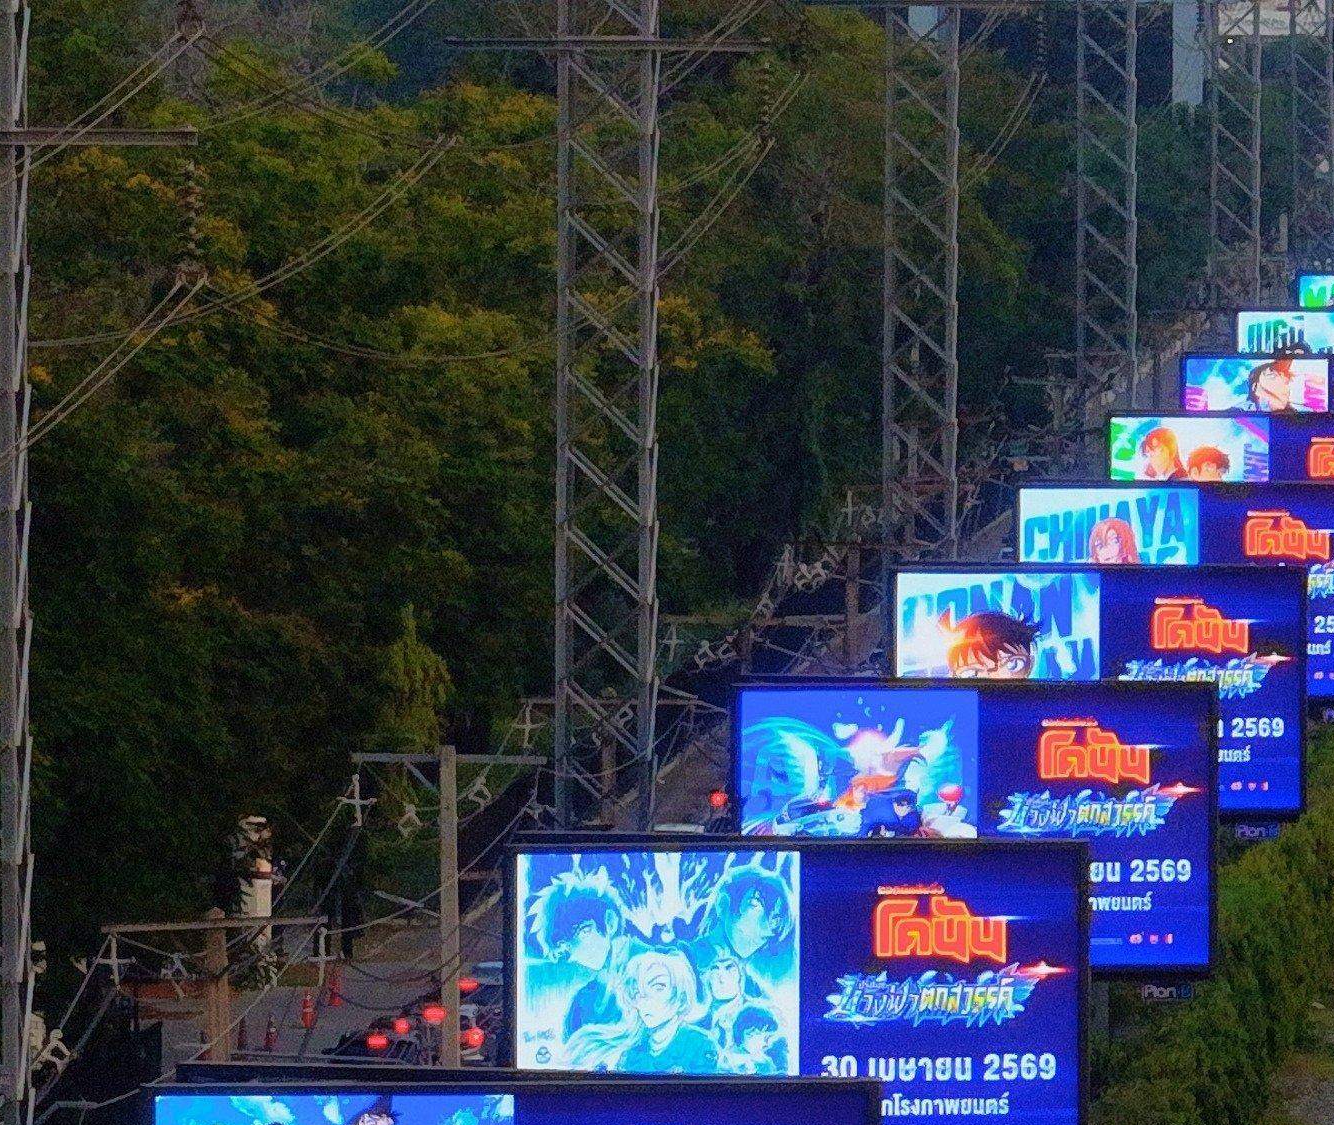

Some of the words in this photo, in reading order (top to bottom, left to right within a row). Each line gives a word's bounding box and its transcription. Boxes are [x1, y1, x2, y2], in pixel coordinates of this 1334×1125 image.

[1153, 604, 1249, 654] โคนัน
[1231, 717, 1285, 738] 2569
[1039, 727, 1150, 784] โคนัน
[1129, 858, 1191, 883] 2569
[875, 896, 1006, 963] โคนัน
[868, 1056, 973, 1082] เมษายน
[983, 1053, 1057, 1081] 2569
[881, 1090, 1009, 1117] กโรงภาพยนตร์
